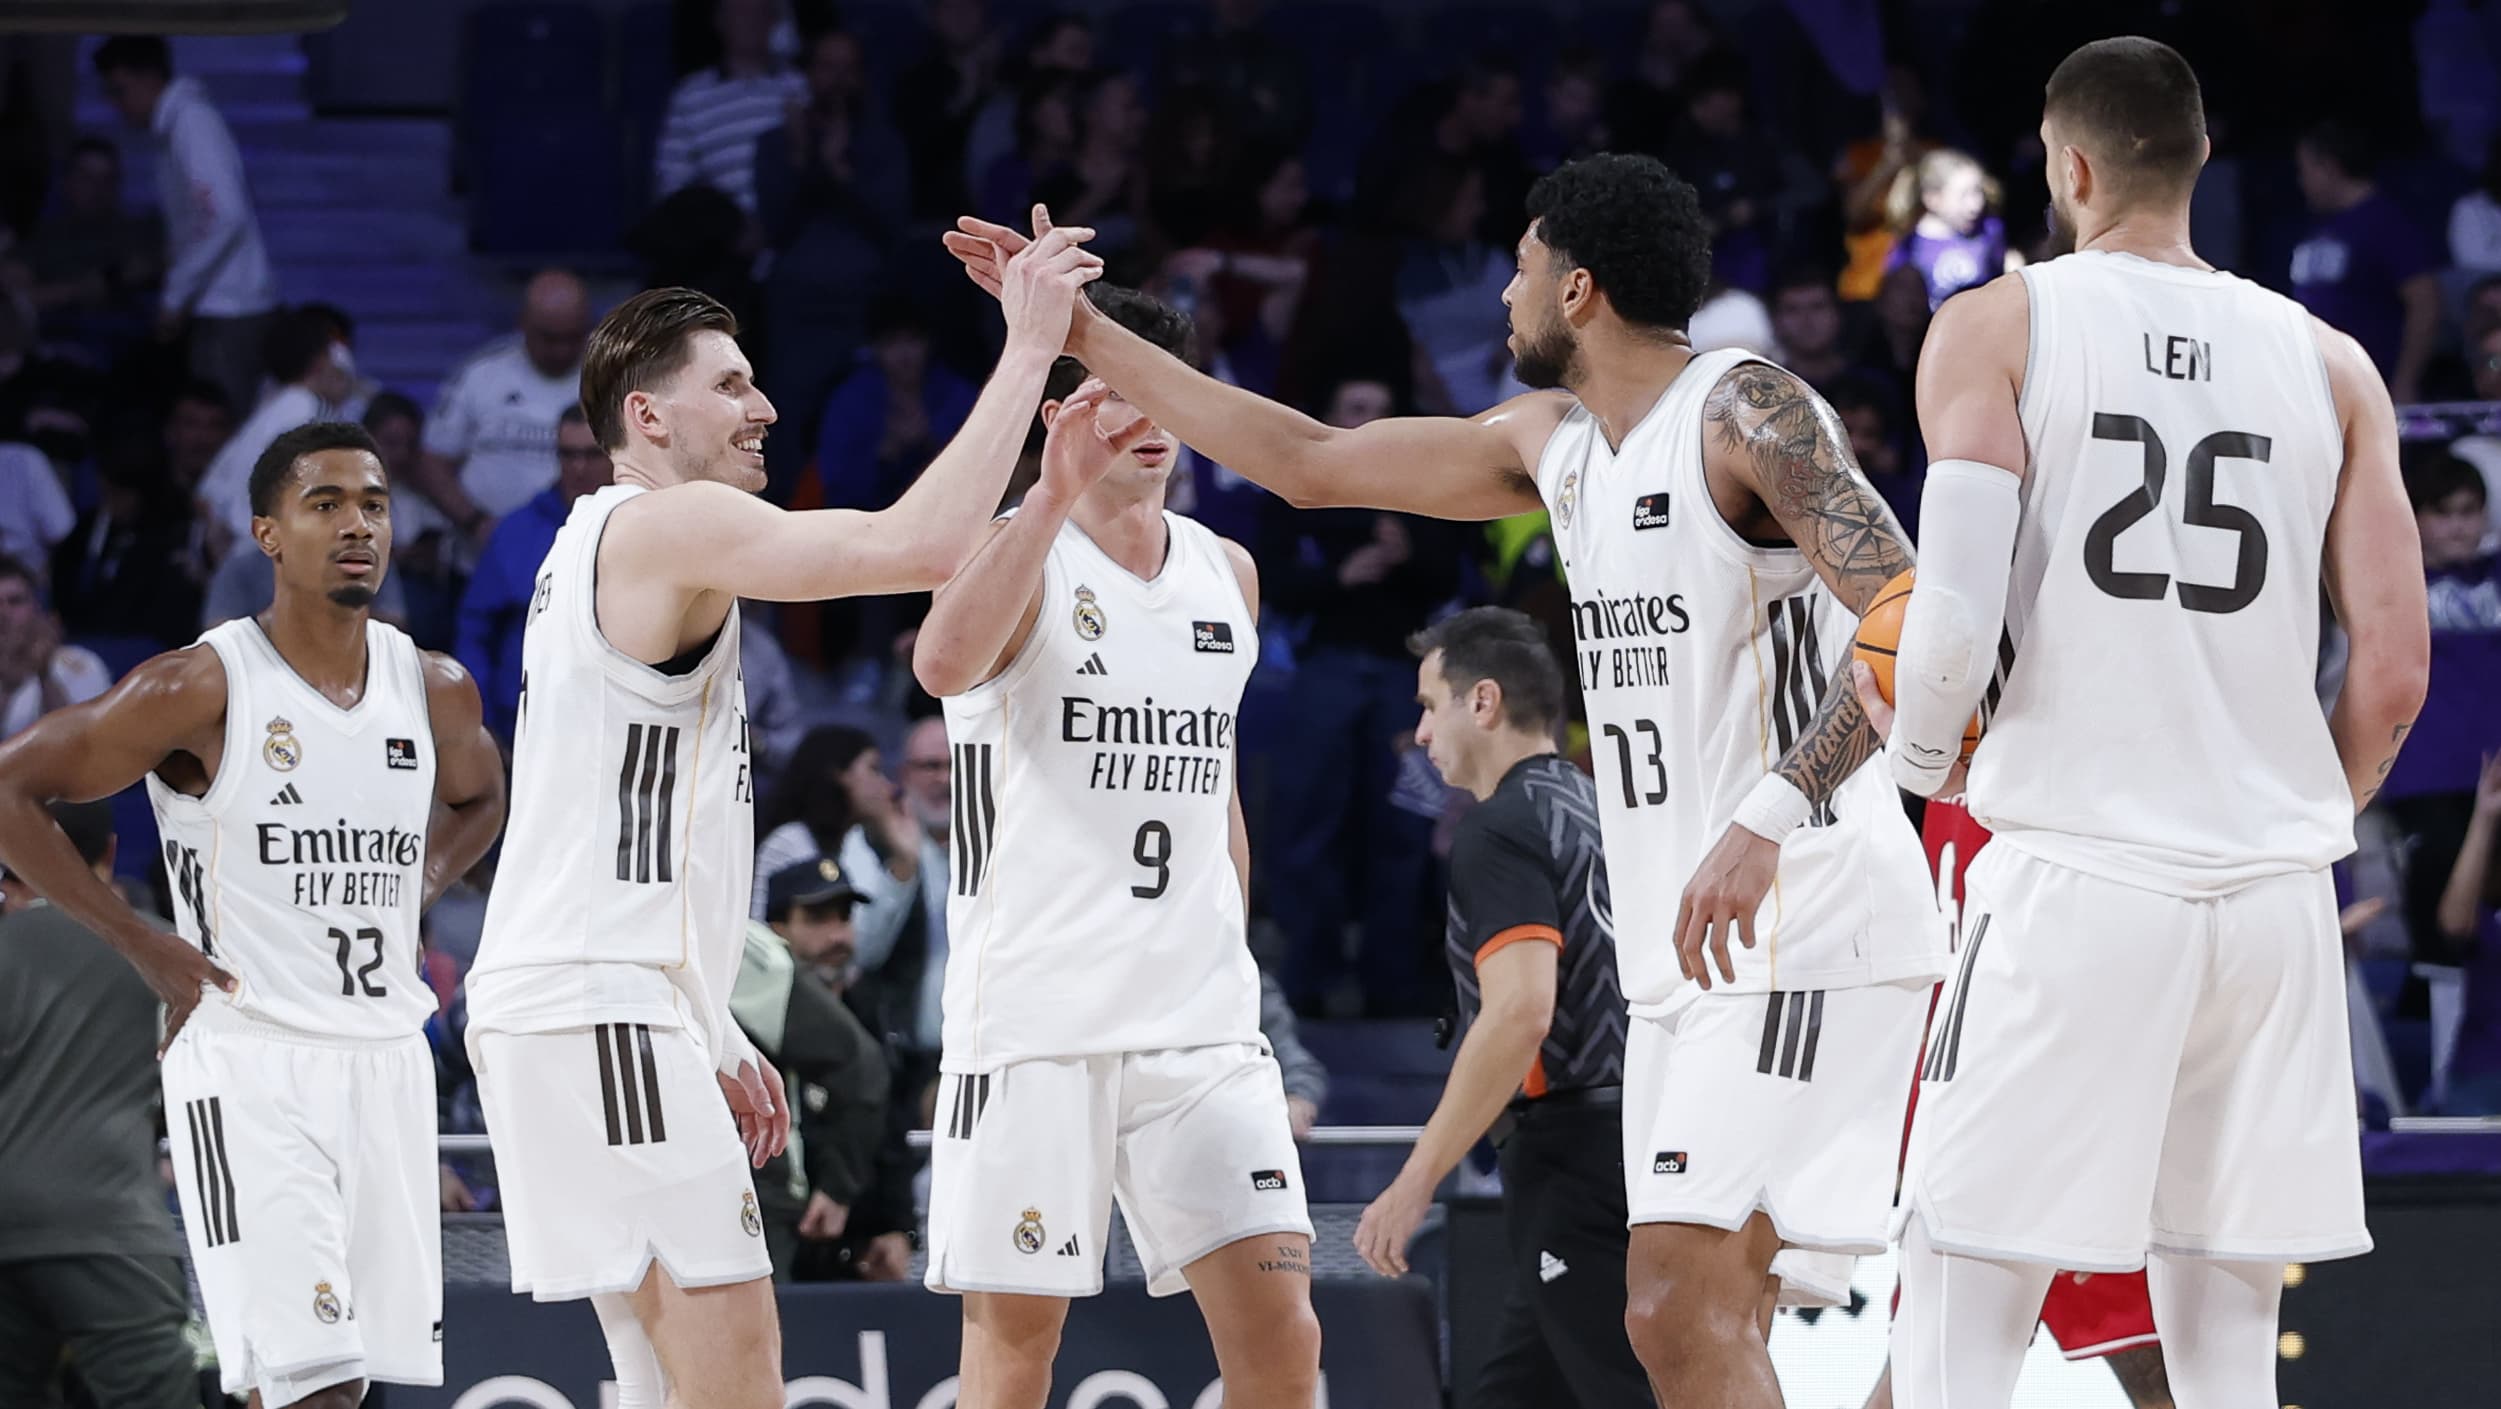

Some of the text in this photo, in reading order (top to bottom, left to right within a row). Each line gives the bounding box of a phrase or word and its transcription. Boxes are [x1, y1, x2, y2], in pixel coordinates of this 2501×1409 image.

[2143, 331, 2212, 382] LEN
[2083, 411, 2273, 615] 25
[1571, 588, 1690, 641] mirates
[1579, 649, 1602, 691] LY
[1061, 696, 1236, 750] Emirate
[1090, 752, 1136, 790] FLY
[1144, 754, 1221, 796] BETTER
[1603, 718, 1669, 809] 13
[256, 817, 421, 867] Emirates
[1131, 819, 1172, 900] 9
[294, 871, 335, 907] FLY
[327, 926, 387, 998] 12
[1257, 1176, 1281, 1189] acb
[1656, 1159, 1680, 1172] acb
